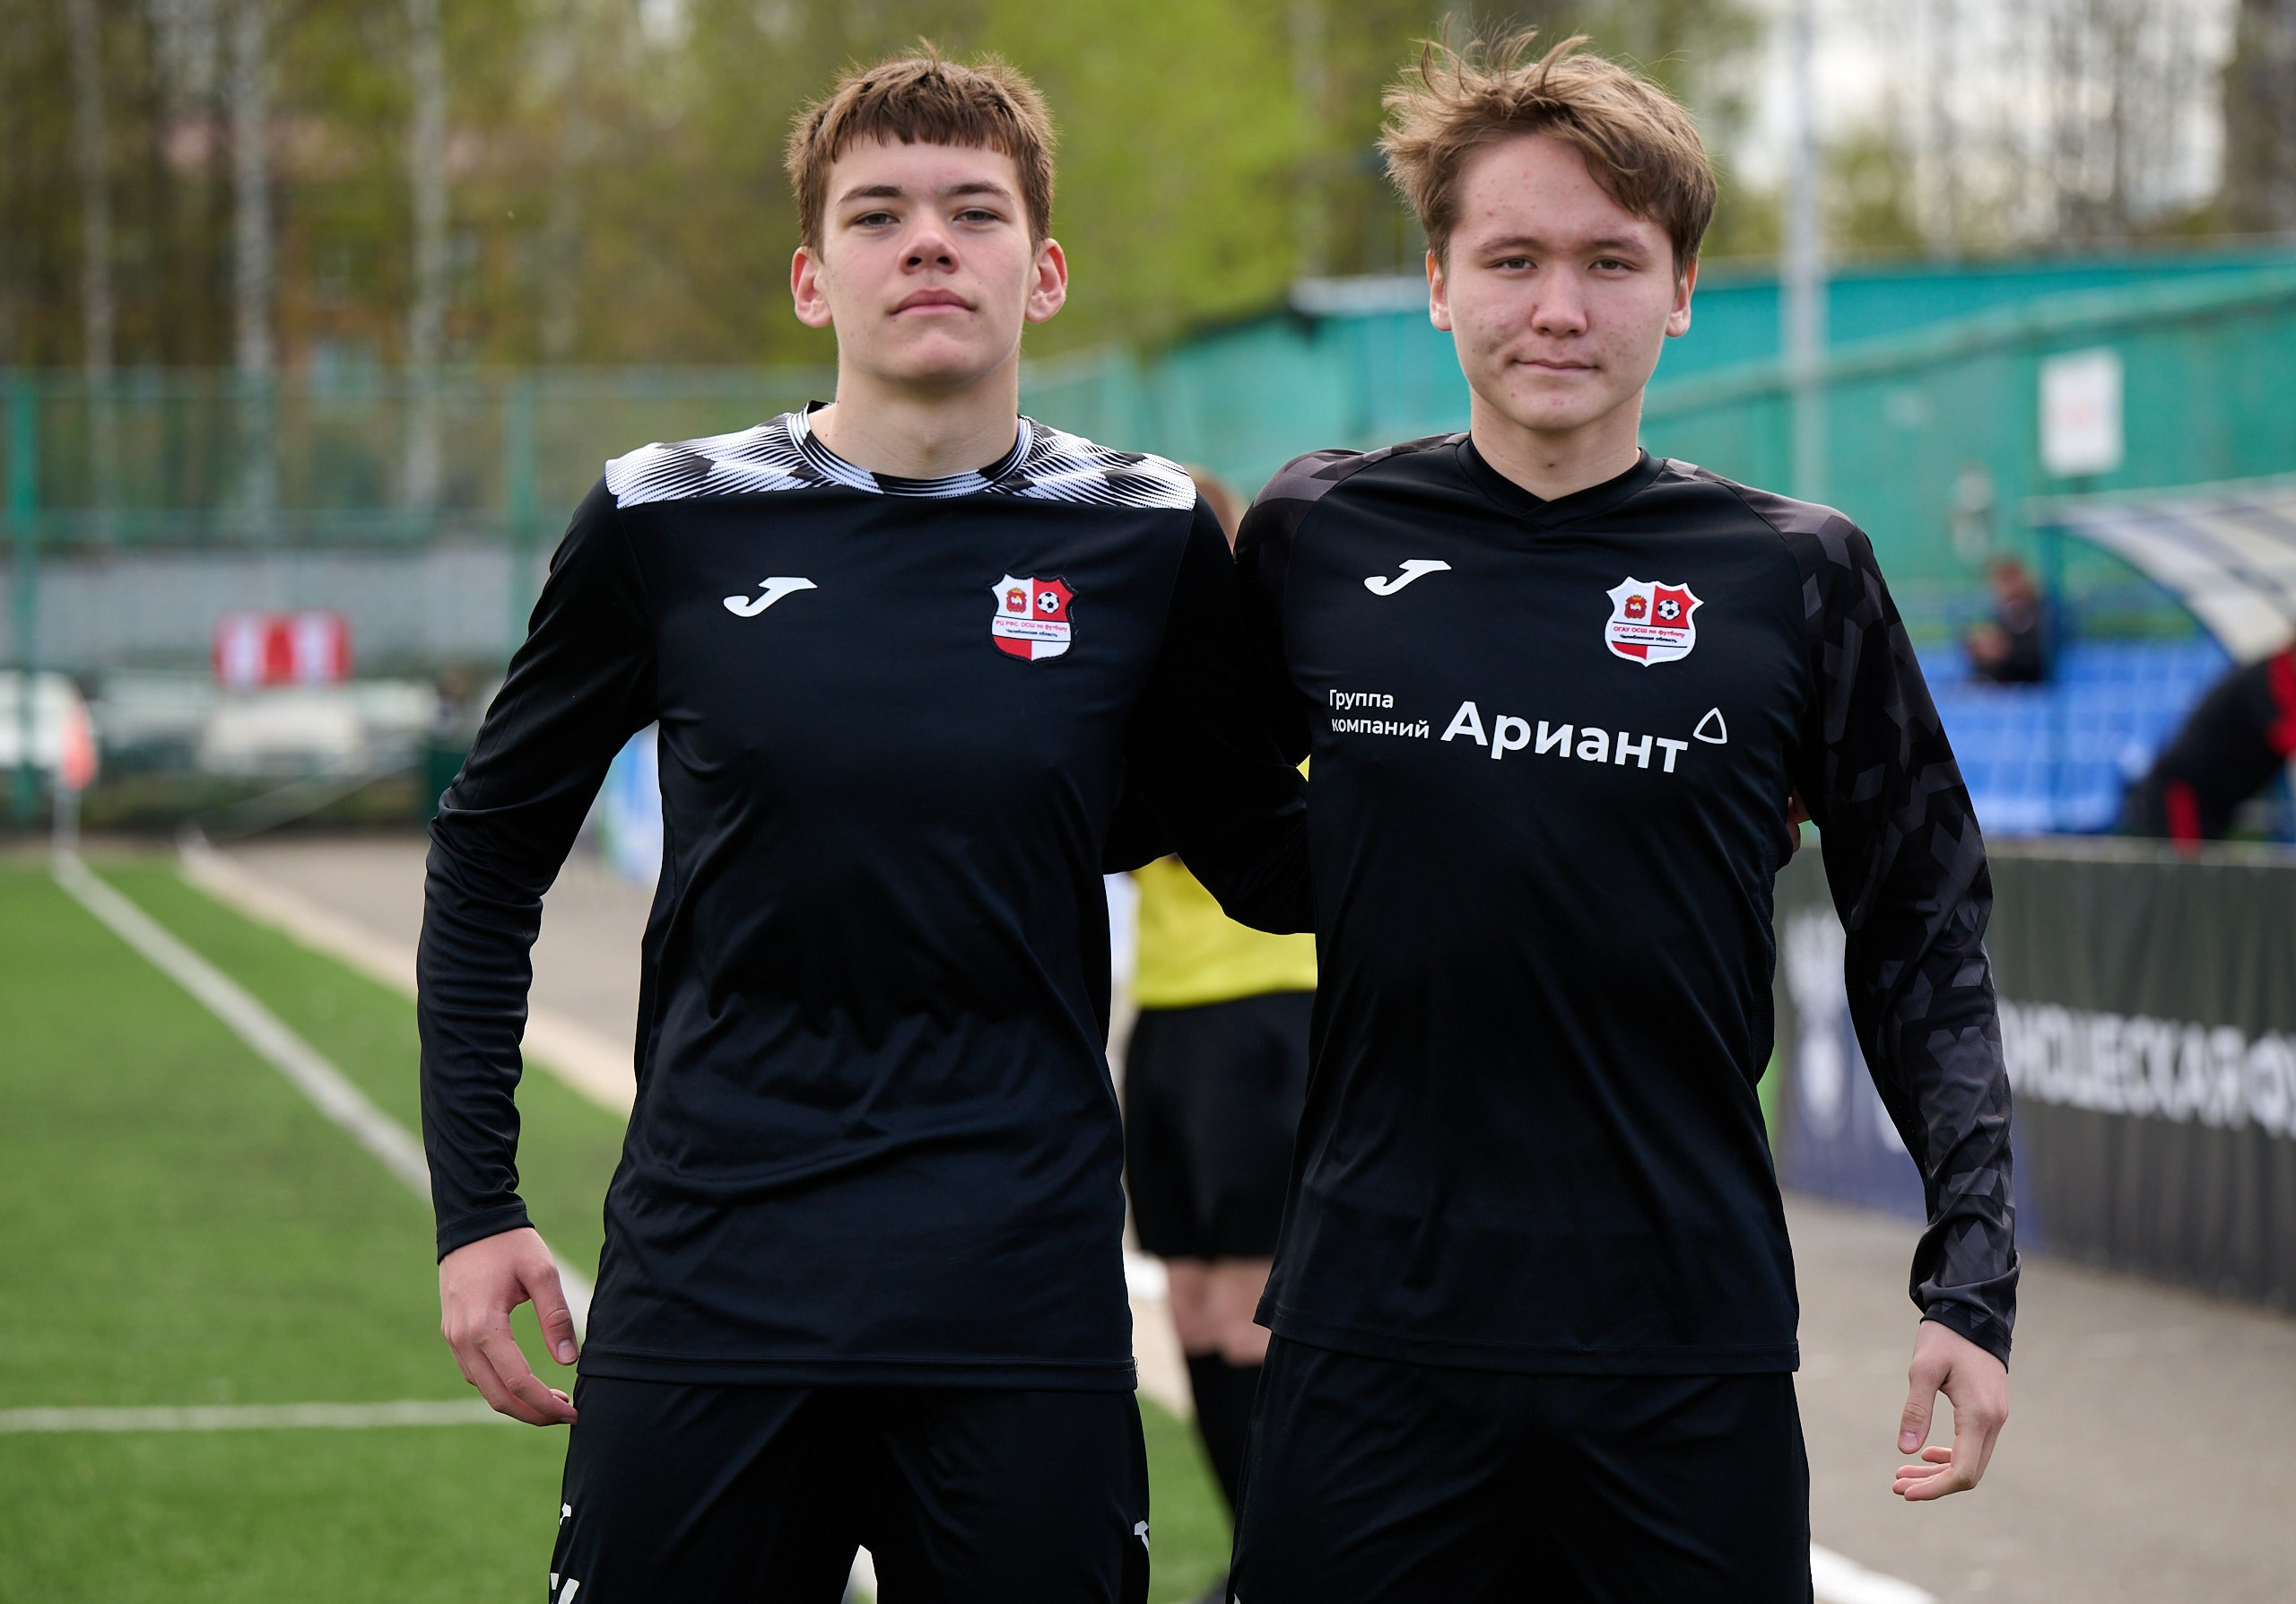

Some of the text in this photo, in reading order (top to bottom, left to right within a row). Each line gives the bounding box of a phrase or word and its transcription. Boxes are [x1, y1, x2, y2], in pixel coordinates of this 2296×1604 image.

[1045, 623, 1067, 632] футболу
[1658, 630, 1685, 638] футболу
[1329, 689, 1394, 710] Группа
[1331, 718, 1430, 739] компаний
[1440, 701, 1689, 773] Ариант
